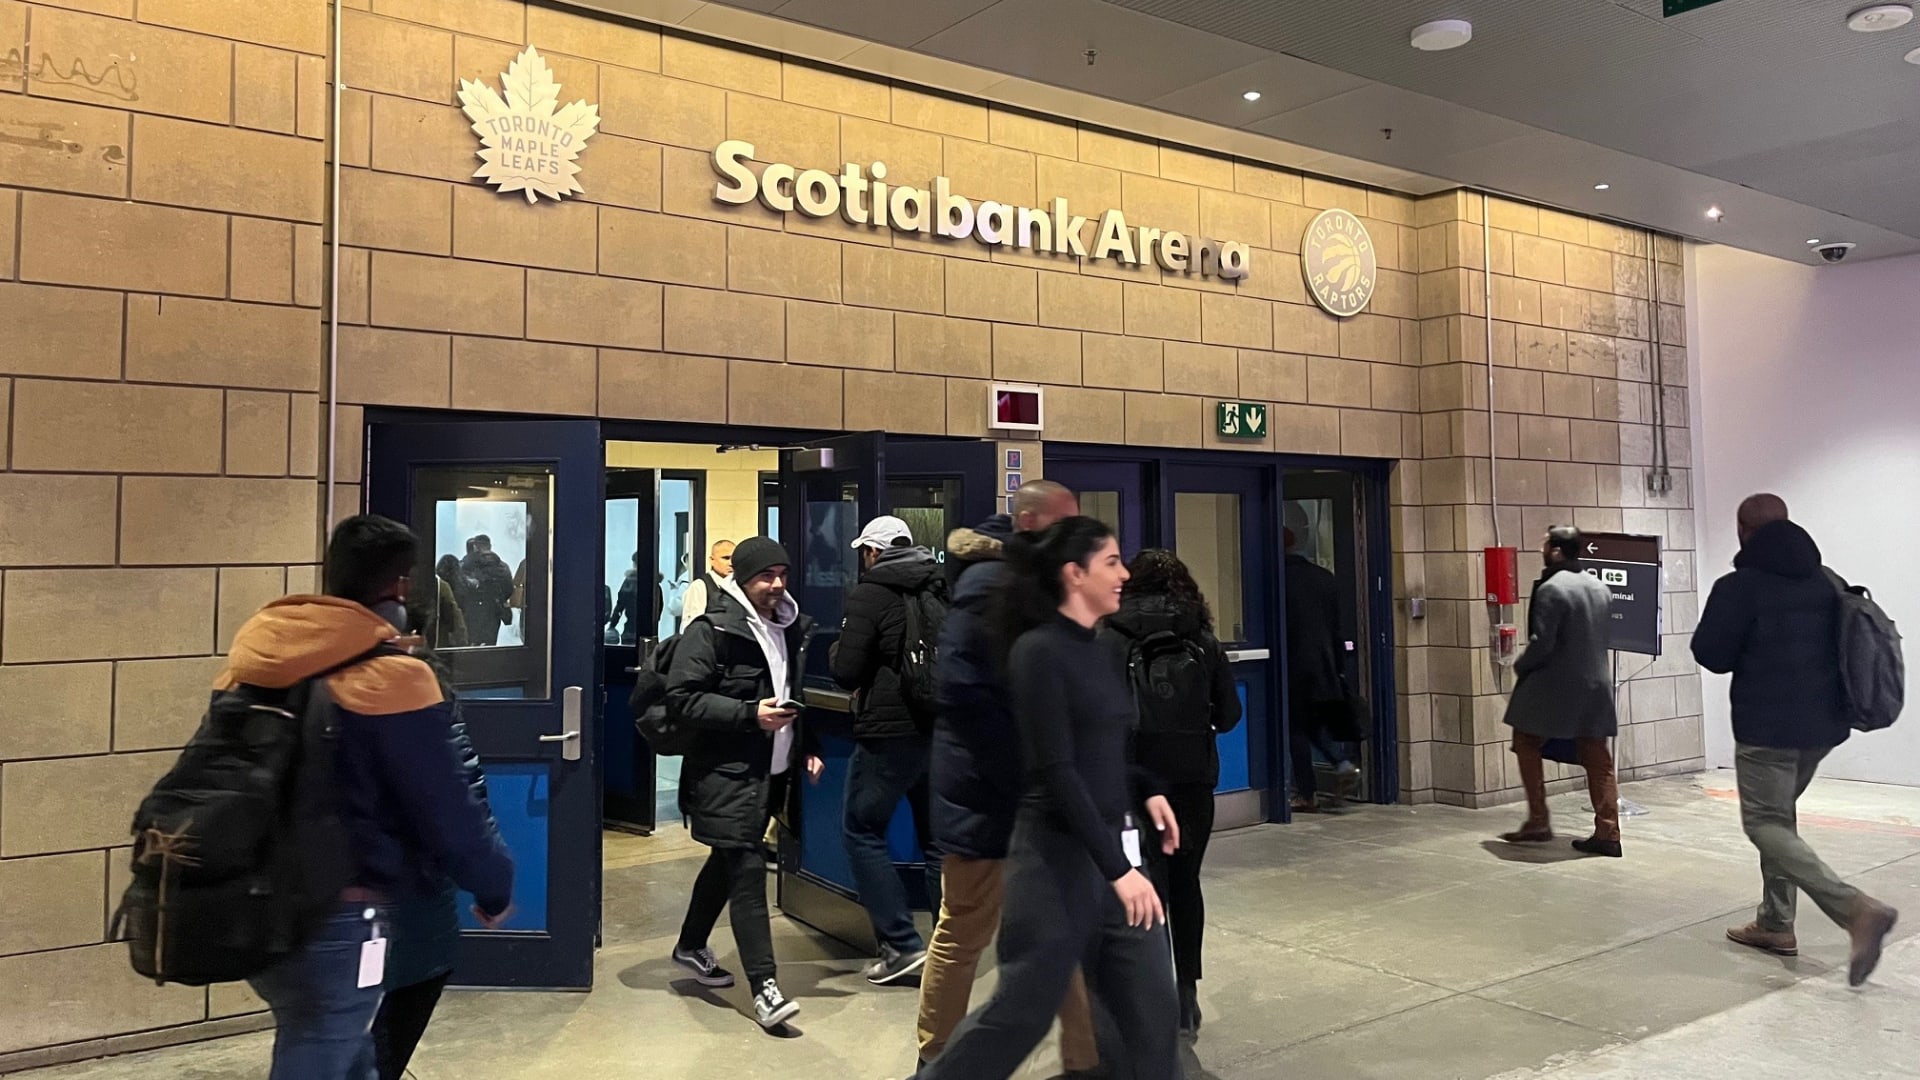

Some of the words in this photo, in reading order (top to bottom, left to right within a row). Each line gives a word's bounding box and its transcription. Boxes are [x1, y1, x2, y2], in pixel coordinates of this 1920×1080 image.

[486, 115, 573, 148] TORONTO
[501, 136, 559, 158] MAPLE
[501, 152, 559, 175] LEAFS
[712, 139, 1088, 257] Scotiabank
[1092, 208, 1250, 280] Arena
[1310, 215, 1369, 254] TORONTO
[1313, 272, 1371, 310] RAPTORS
[1009, 452, 1019, 465] P
[1009, 476, 1019, 489] A
[1605, 571, 1623, 583] GO
